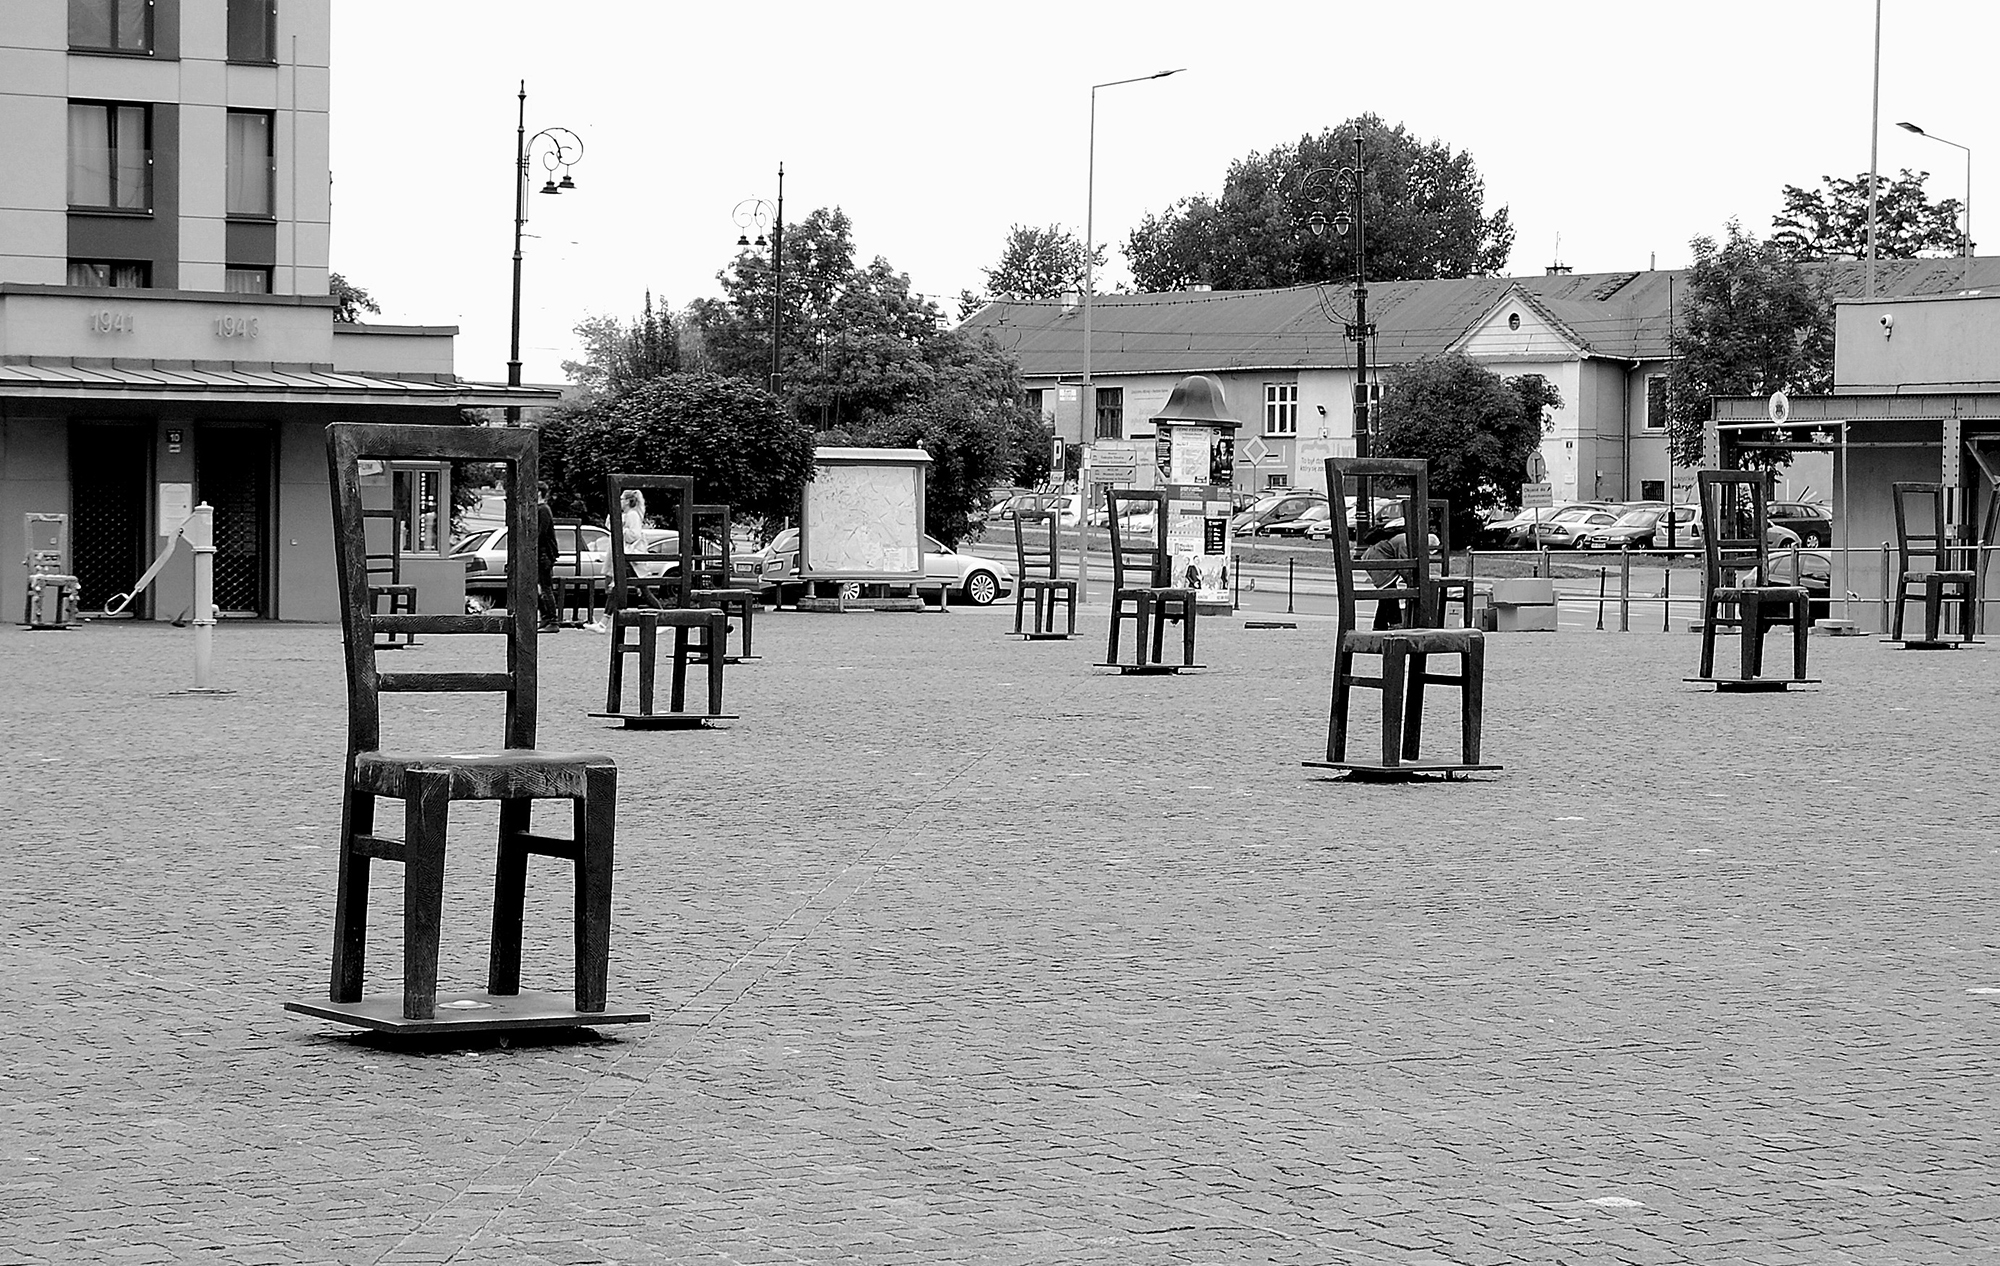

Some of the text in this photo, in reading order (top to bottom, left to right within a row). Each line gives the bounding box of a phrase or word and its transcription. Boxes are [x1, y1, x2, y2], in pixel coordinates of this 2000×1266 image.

[90, 310, 135, 334] 1941
[214, 314, 260, 339] 1943
[1053, 440, 1062, 467] P
